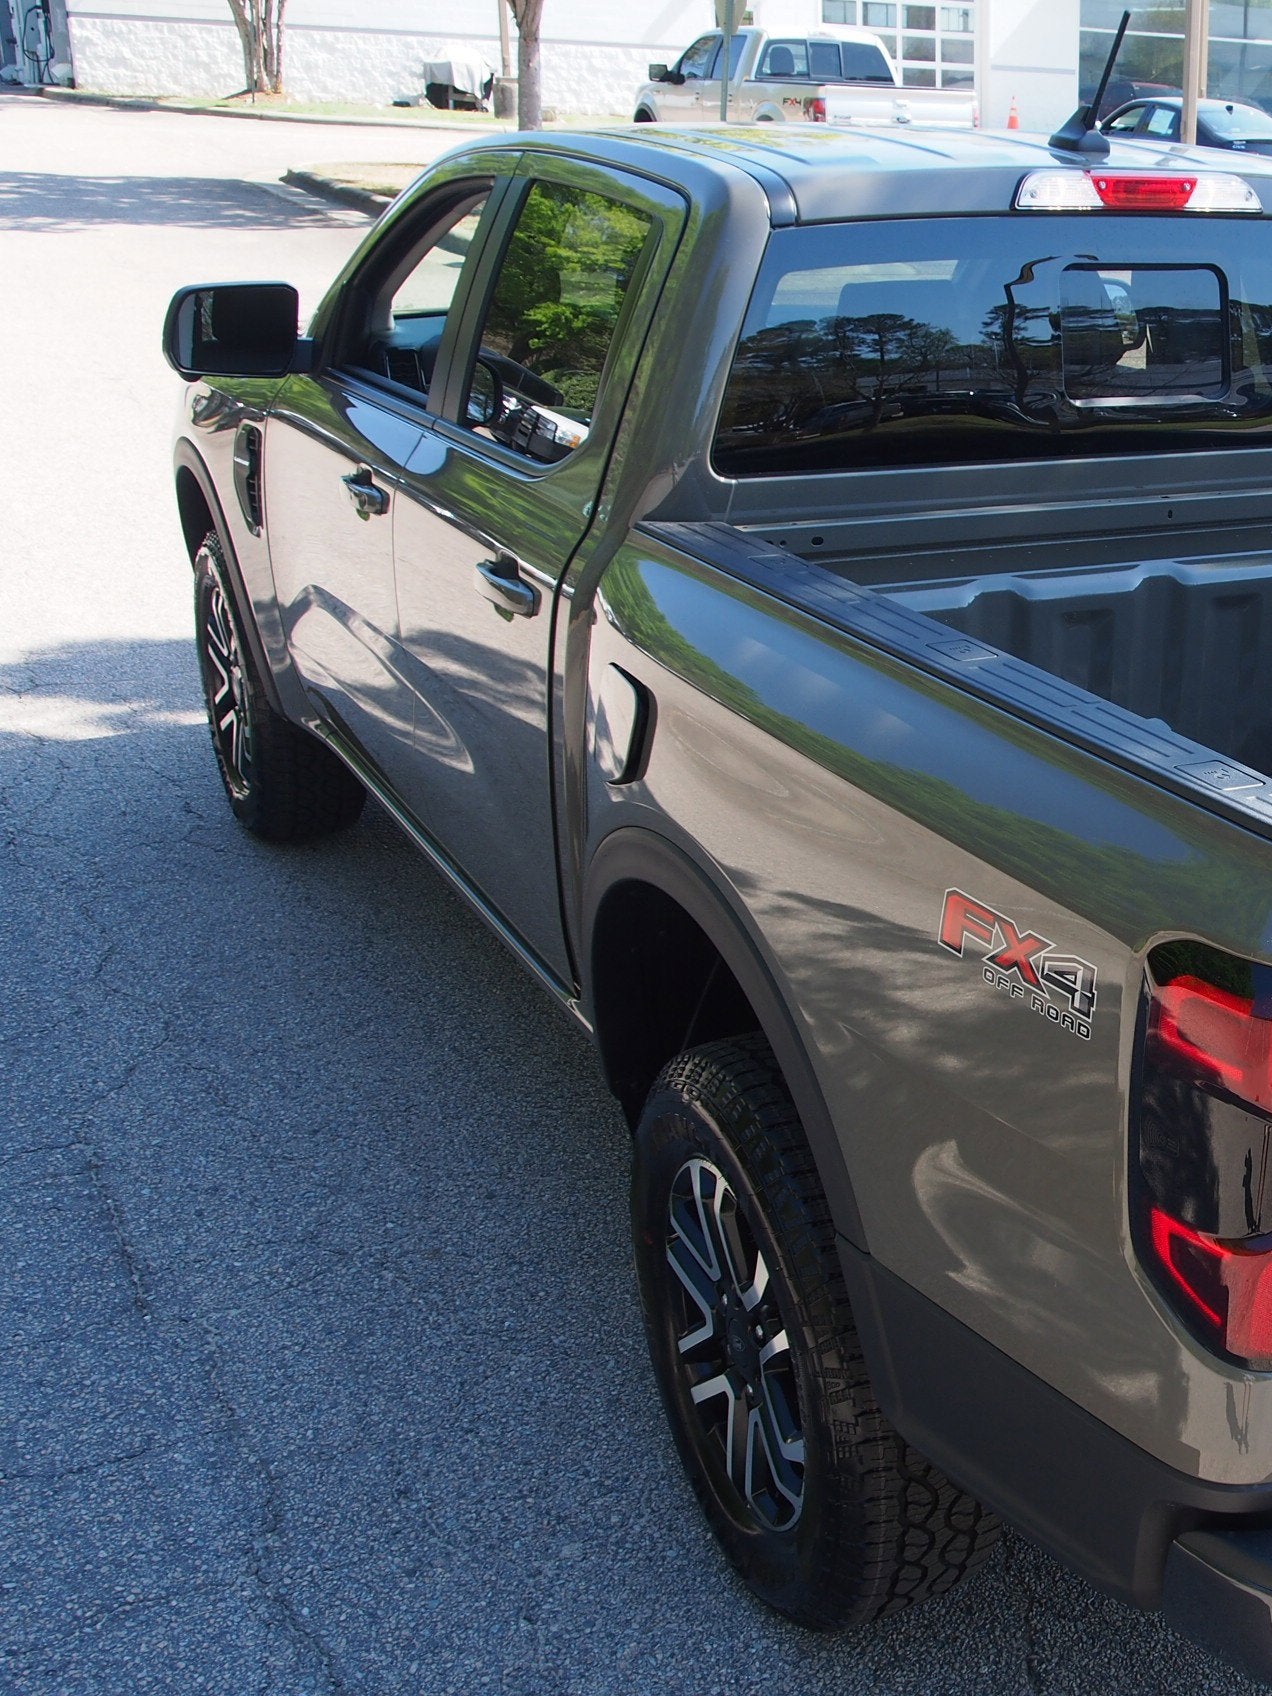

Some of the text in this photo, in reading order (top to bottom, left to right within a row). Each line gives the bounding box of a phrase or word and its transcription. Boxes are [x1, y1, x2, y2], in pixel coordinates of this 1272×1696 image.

[938, 887, 1098, 1022] FX4
[982, 966, 1092, 1040] OFF ROAD
